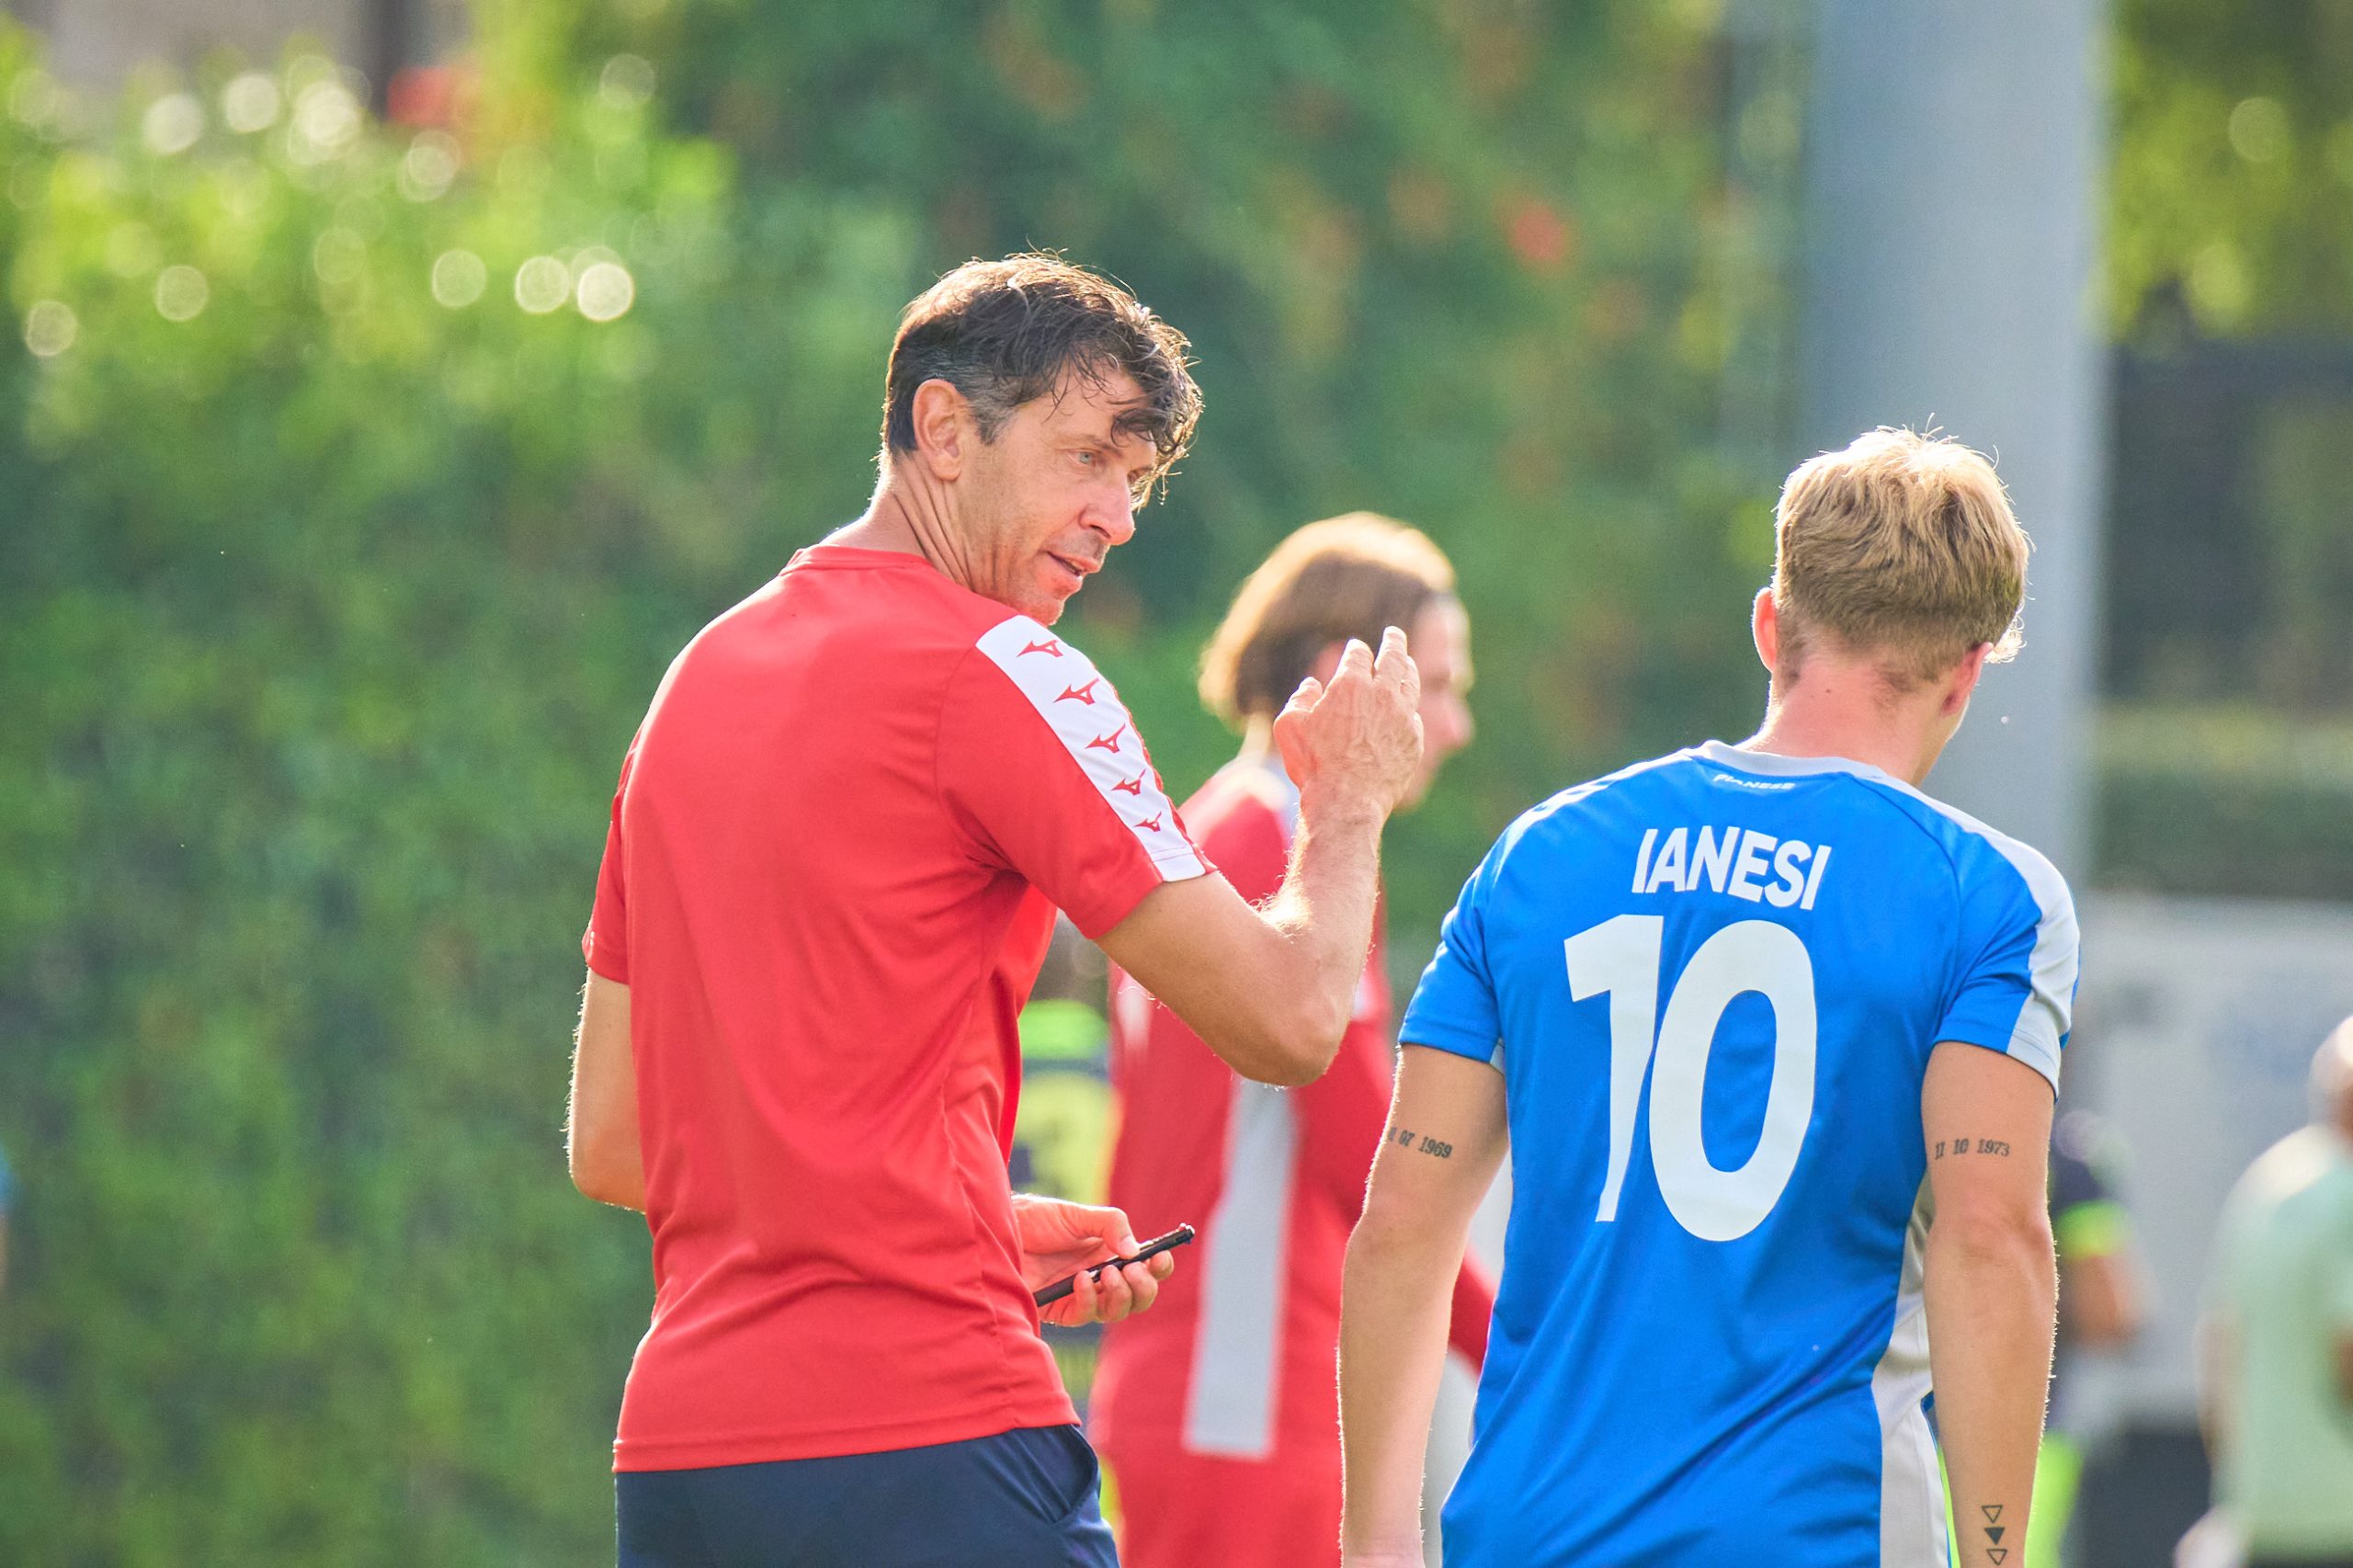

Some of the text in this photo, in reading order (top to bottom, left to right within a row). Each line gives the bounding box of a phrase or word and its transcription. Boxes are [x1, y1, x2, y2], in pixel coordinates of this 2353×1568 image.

[1631, 825, 1832, 911] IANESI
[1563, 914, 1818, 1242] 10
[1418, 1136, 1453, 1159] 1969
[1953, 1138, 1970, 1155] 10
[1977, 1139, 2010, 1157] 1973
